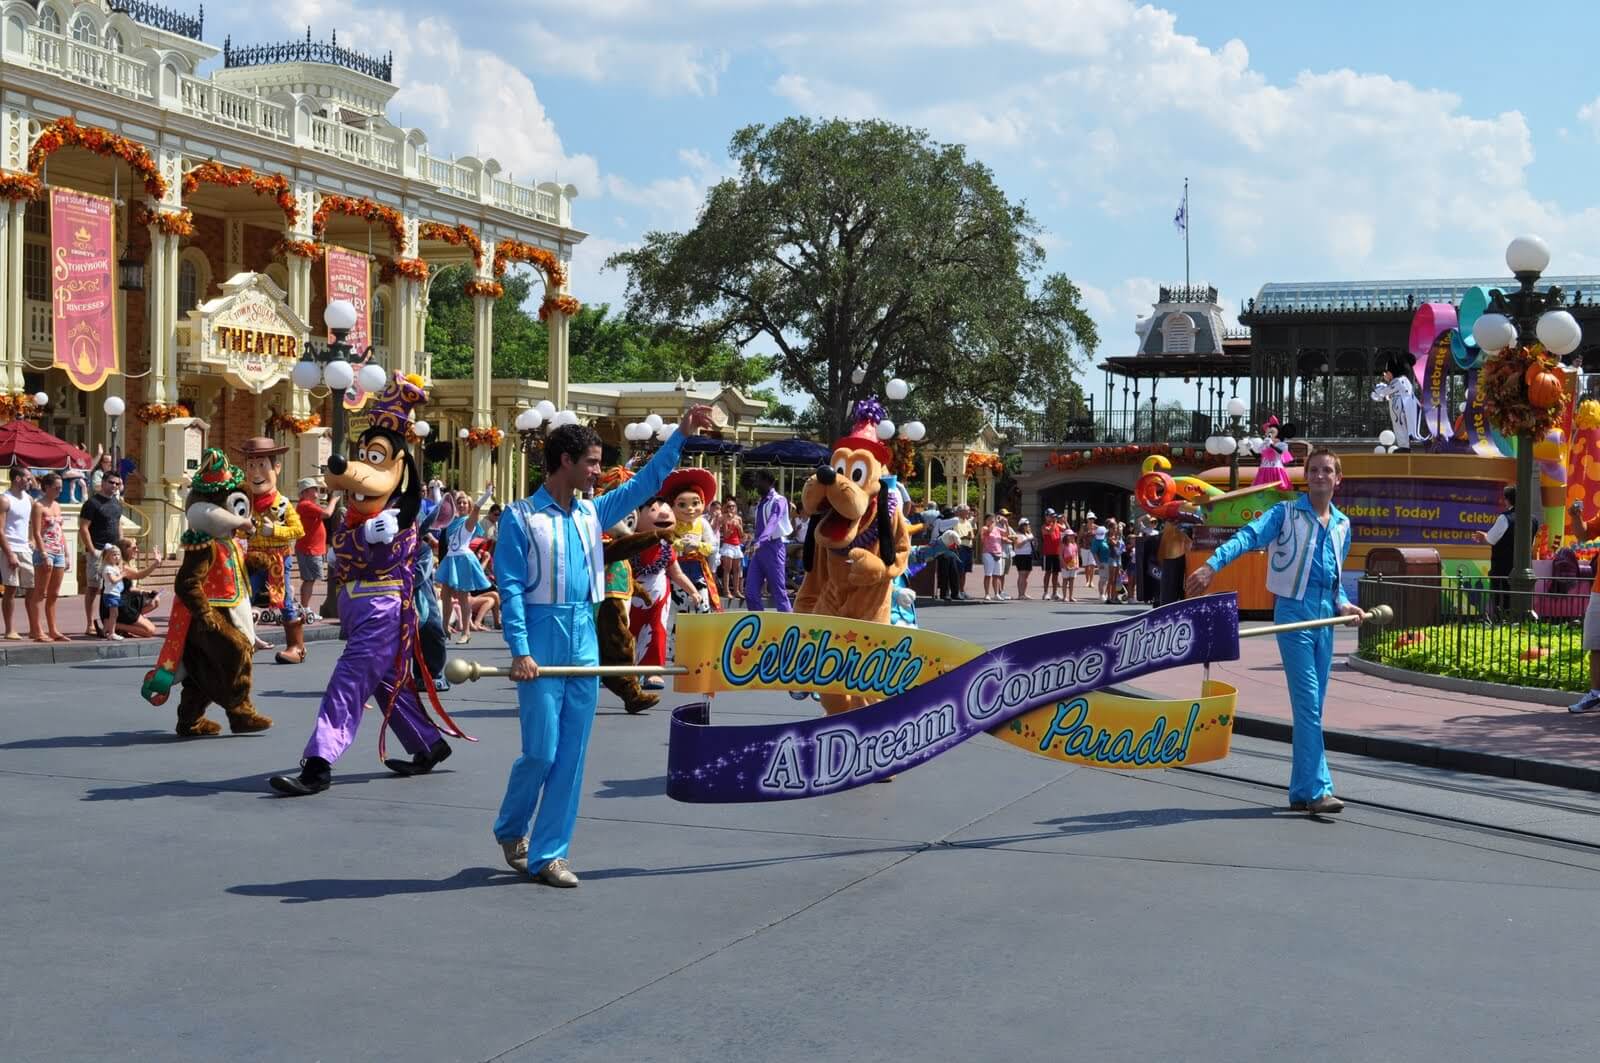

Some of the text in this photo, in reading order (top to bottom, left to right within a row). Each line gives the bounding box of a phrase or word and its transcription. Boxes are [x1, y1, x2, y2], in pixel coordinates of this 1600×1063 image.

[218, 326, 296, 357] THEATER
[1338, 505, 1440, 520] elebrate Today!
[721, 614, 923, 696] Celebrate
[763, 618, 1192, 789] A Dream Come True
[1039, 697, 1201, 765] Parade!
